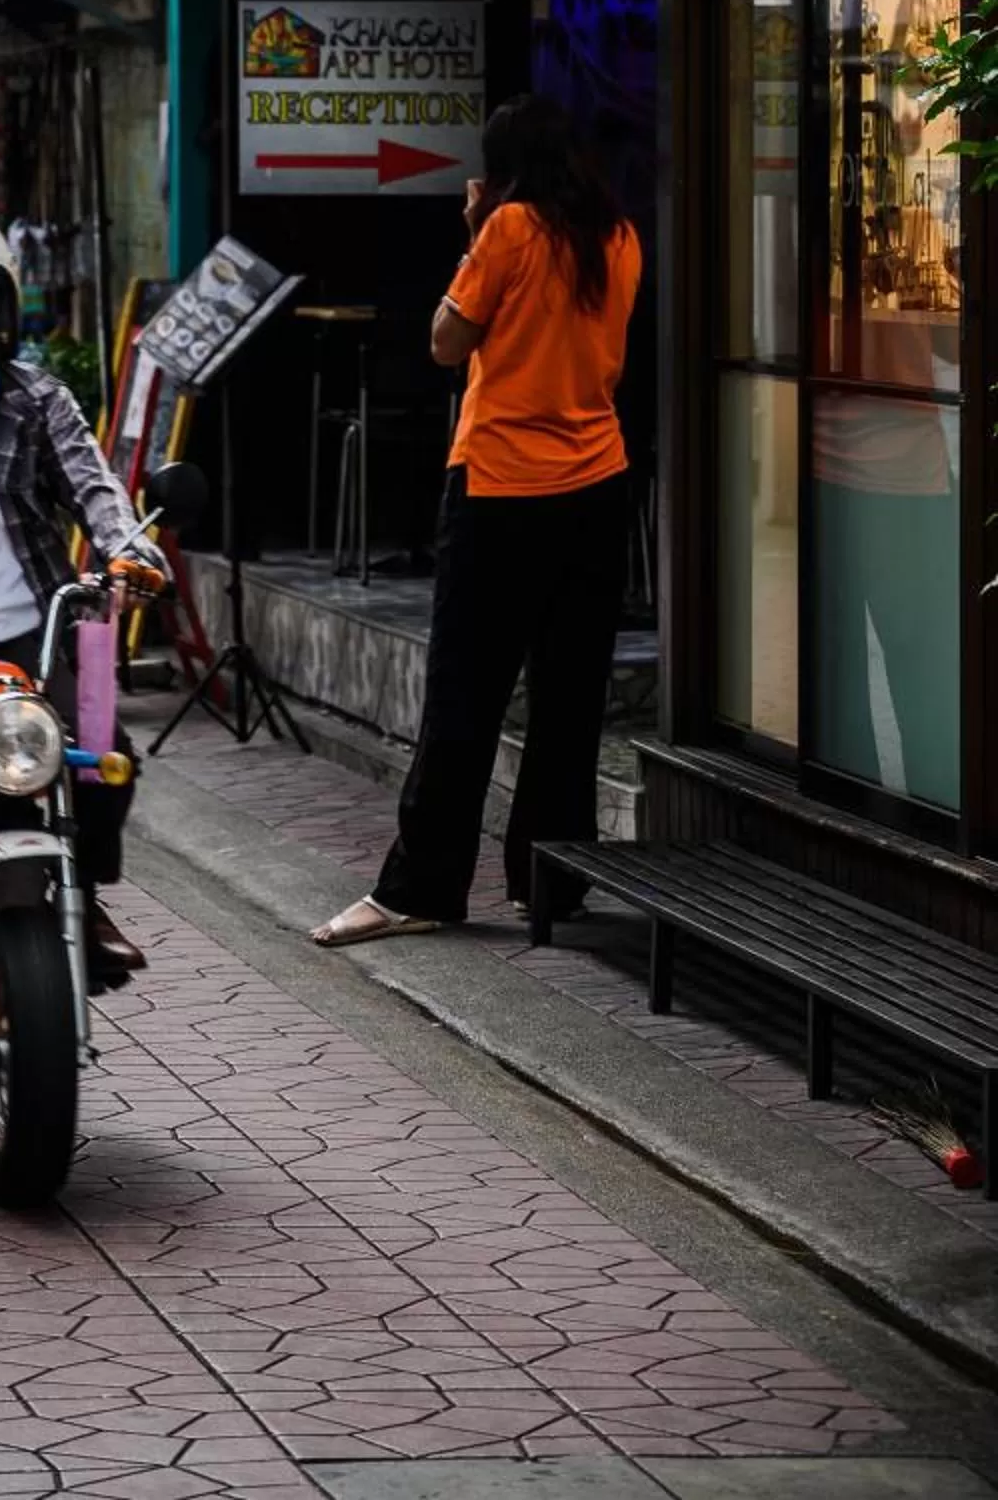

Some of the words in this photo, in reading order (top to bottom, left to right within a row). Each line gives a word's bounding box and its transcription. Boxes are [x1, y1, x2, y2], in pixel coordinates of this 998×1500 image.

[328, 17, 478, 47] KHAOSAN
[322, 50, 382, 80] ART
[387, 50, 484, 80] HOTEL
[247, 90, 484, 126] RECEPTION
